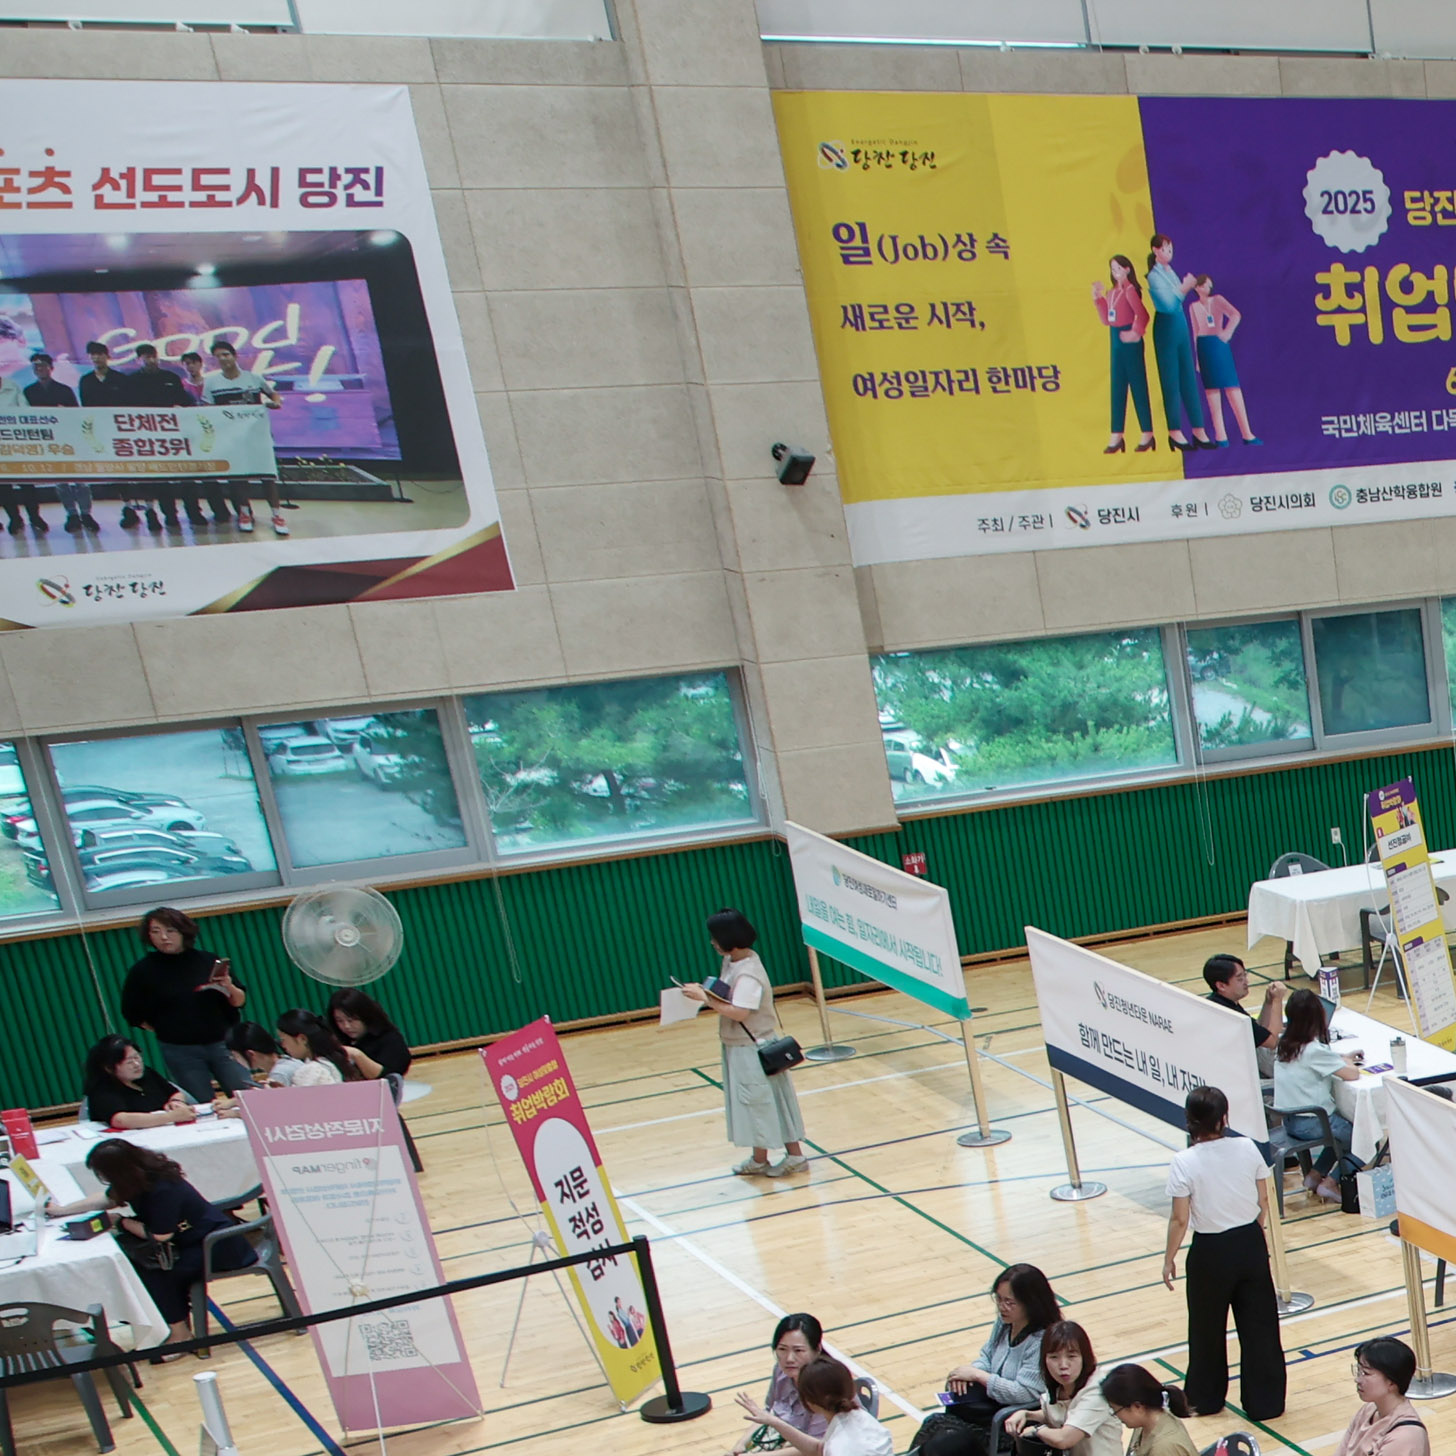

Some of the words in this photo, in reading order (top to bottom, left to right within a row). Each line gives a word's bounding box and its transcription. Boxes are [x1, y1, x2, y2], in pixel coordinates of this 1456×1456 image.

[92, 166, 280, 210] 선도도시
[298, 166, 384, 209] 당진
[1320, 190, 1376, 215] 2025
[986, 231, 1011, 260] 속
[840, 301, 919, 332] 새로운
[927, 300, 986, 331] 시작,
[851, 368, 980, 400] 여성일자리
[987, 364, 1061, 395] 한마당
[113, 413, 180, 433] 단체전
[1321, 406, 1427, 439] 국민체육센터
[112, 437, 193, 457] 종합3위
[1249, 493, 1317, 513] 당진시의회
[1355, 482, 1443, 504] 충남산학융합원
[977, 516, 1005, 534] 주최
[1016, 513, 1044, 532] 주관
[1097, 504, 1141, 526] 당진시
[1170, 501, 1199, 519] 후원
[1148, 1012, 1174, 1034] NARAE
[1078, 1022, 1100, 1054] 함께
[1101, 1033, 1135, 1070] 만드는
[1135, 1048, 1149, 1077] 내
[1165, 1062, 1179, 1091] 내
[510, 1077, 571, 1125] 취업박람회
[554, 1165, 590, 1204] 지문
[568, 1202, 604, 1241] 적성
